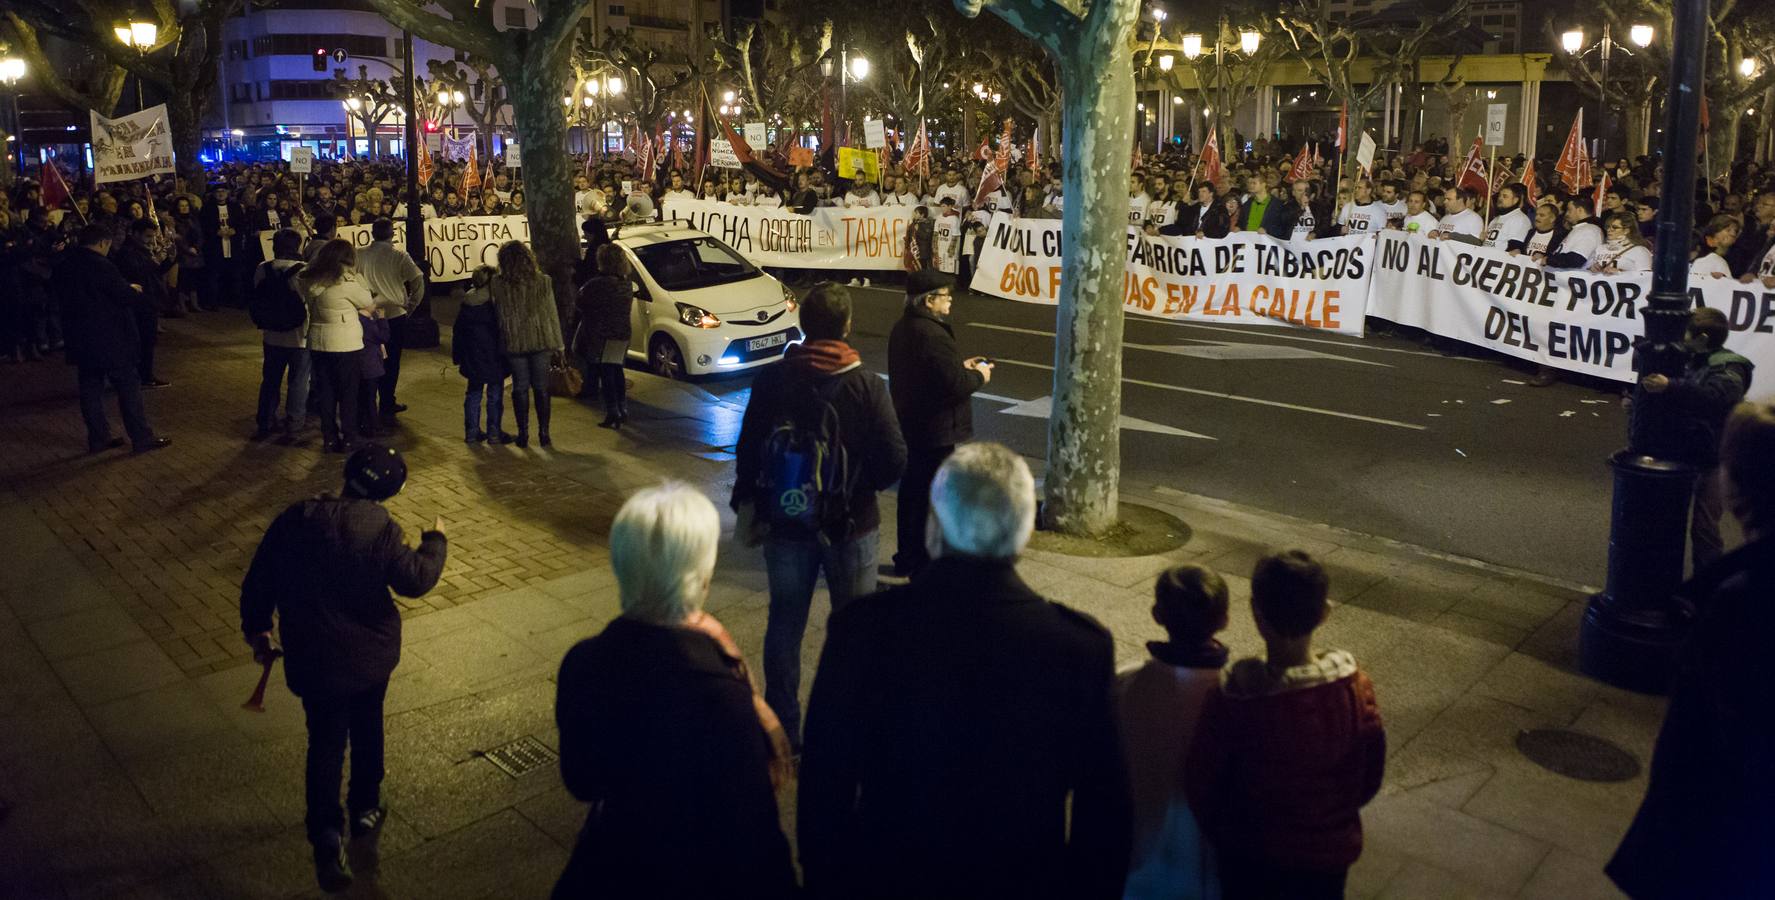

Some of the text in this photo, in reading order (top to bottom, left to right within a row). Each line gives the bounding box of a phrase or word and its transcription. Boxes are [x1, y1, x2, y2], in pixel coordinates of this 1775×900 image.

[1490, 121, 1501, 132] NO
[428, 222, 513, 242] NUESTRA
[818, 229, 835, 248] EN
[841, 217, 911, 258] TABAC
[1296, 217, 1315, 227] NO
[1347, 219, 1369, 230] NO
[451, 243, 473, 275] SE
[1214, 243, 1246, 274] DE
[1255, 243, 1364, 280] TABACOS
[1382, 238, 1410, 272] NO
[1417, 245, 1444, 280] AL
[1452, 253, 1559, 307] CIERRE
[1566, 276, 1641, 319] POR
[1000, 262, 1039, 297] 600
[1162, 283, 1198, 314] EN
[1203, 284, 1241, 316] LA
[1249, 285, 1340, 328] CALLE
[751, 338, 769, 349] 7647
[1484, 306, 1646, 371] DEL EMP
